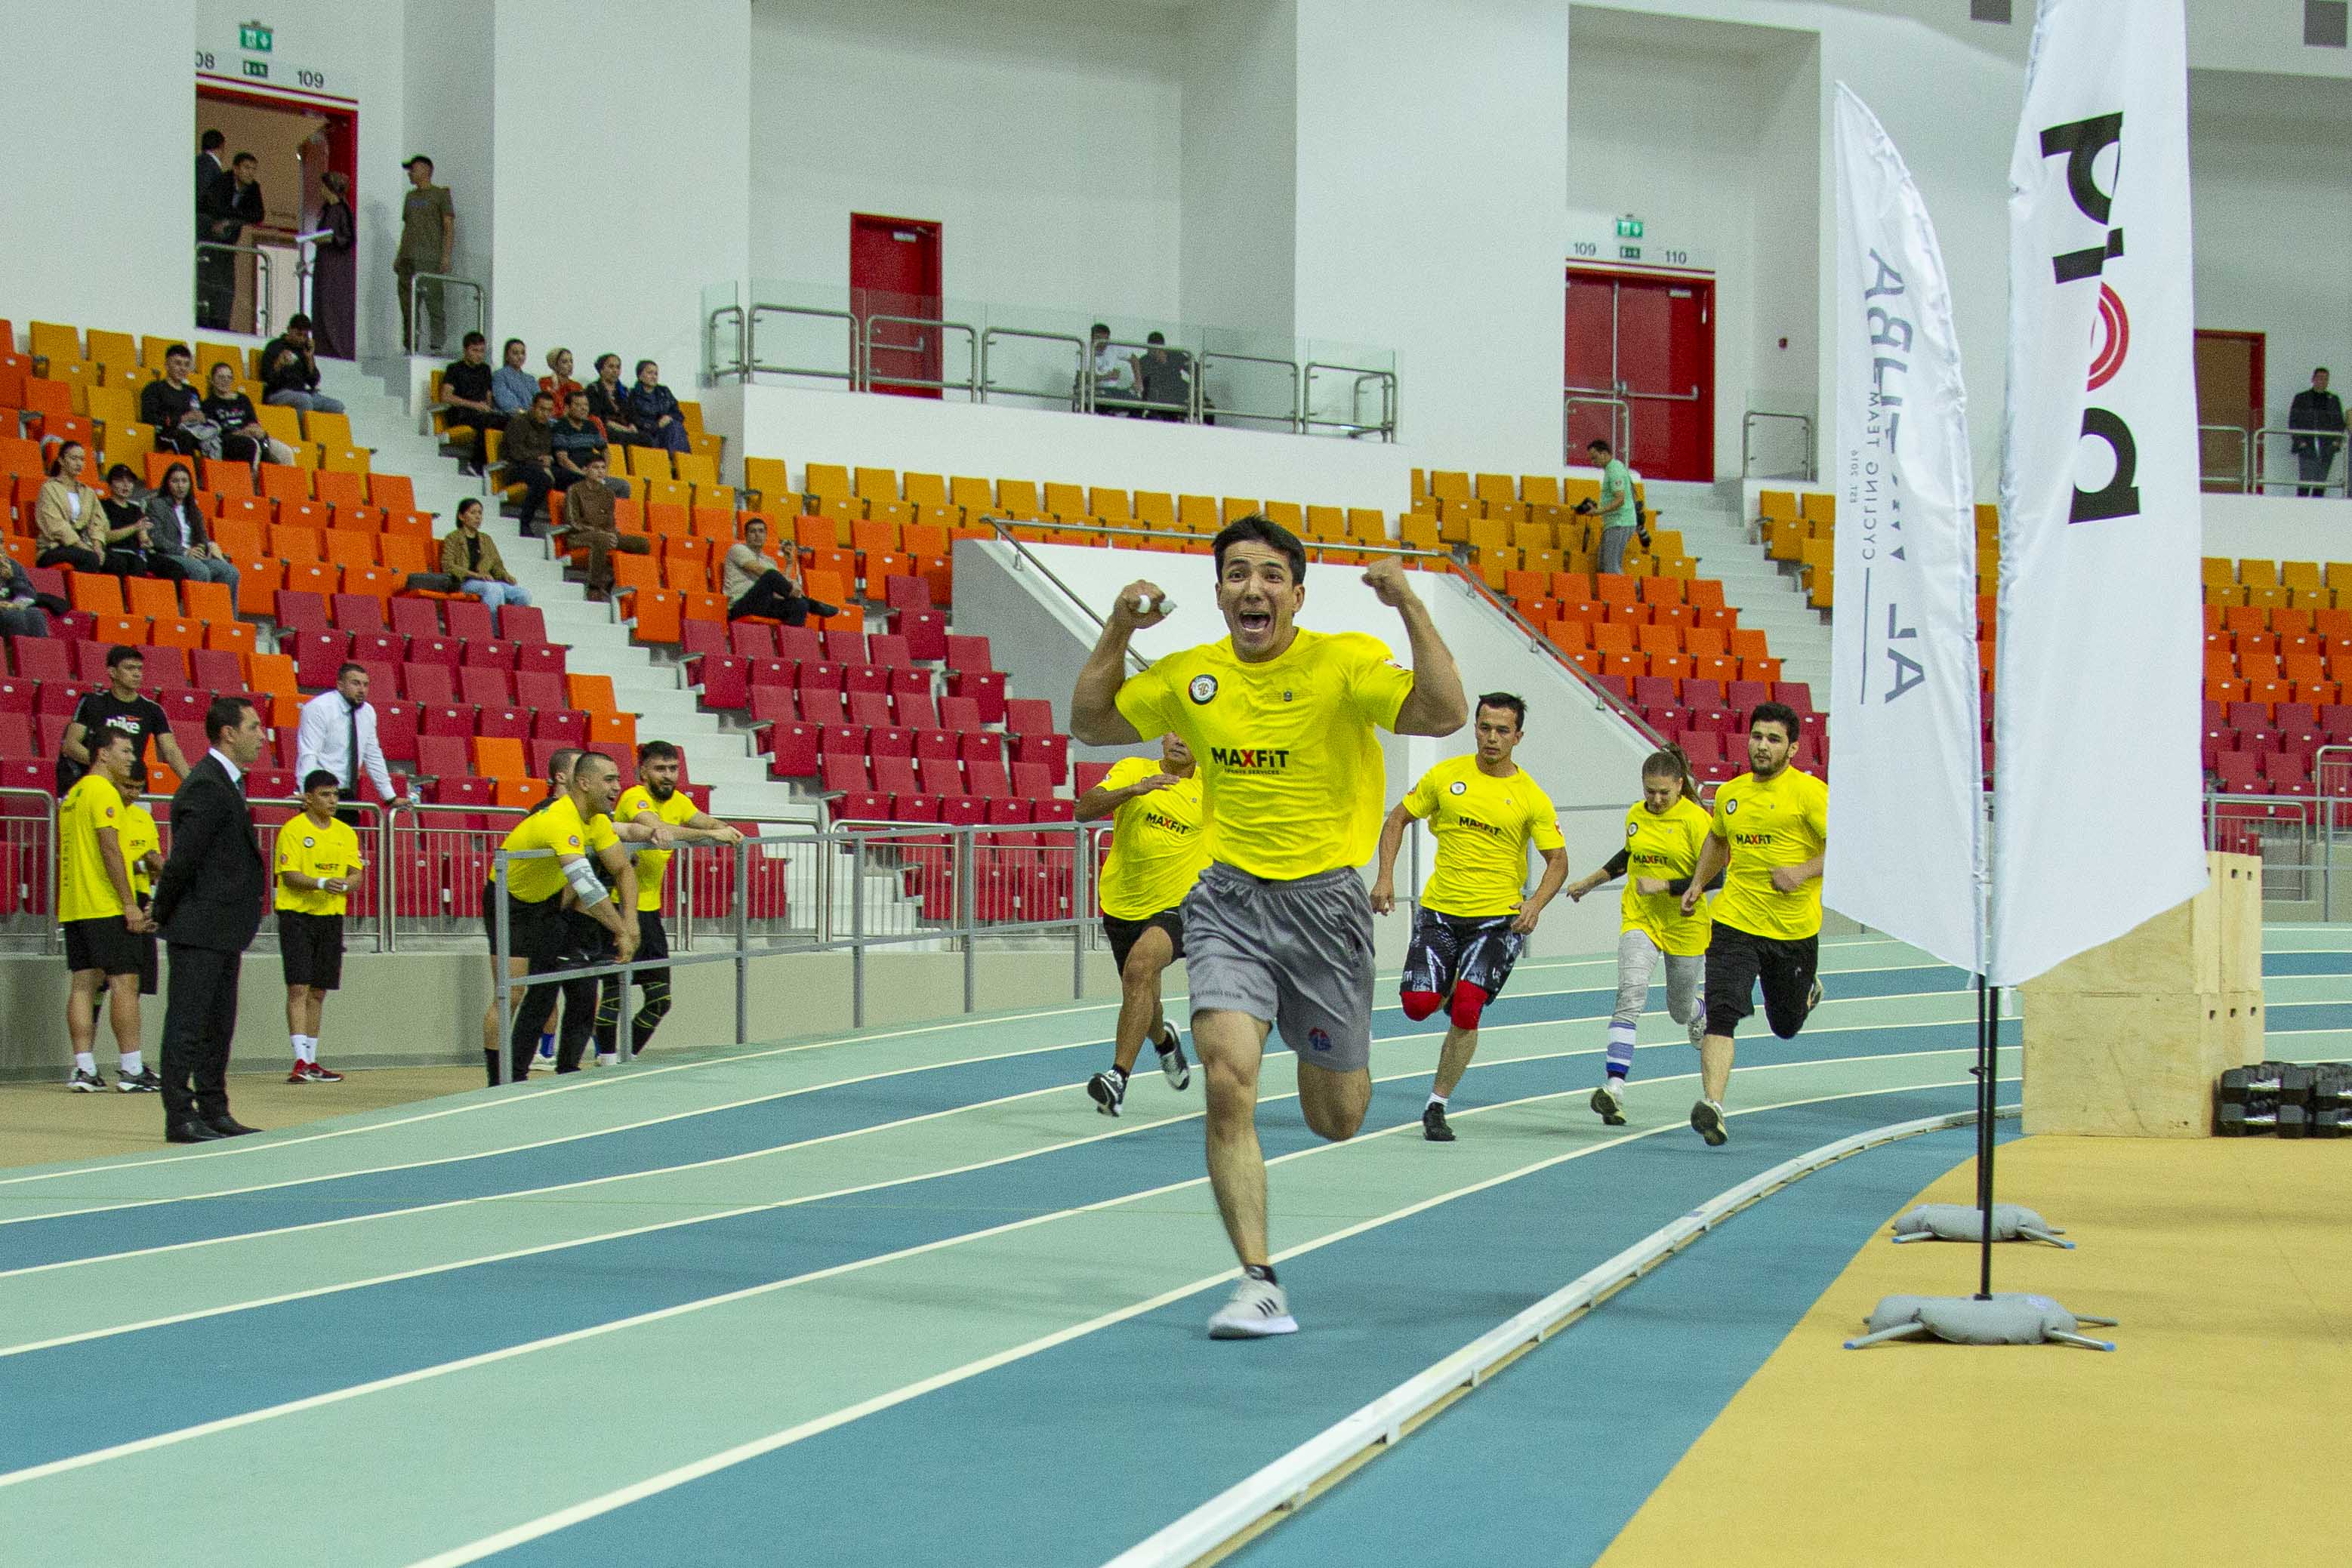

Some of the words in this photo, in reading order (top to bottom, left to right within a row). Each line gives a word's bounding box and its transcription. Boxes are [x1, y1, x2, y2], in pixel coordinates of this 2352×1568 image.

[297, 70, 325, 88] 109
[1574, 242, 1597, 257] 109
[1666, 250, 1687, 264] 110
